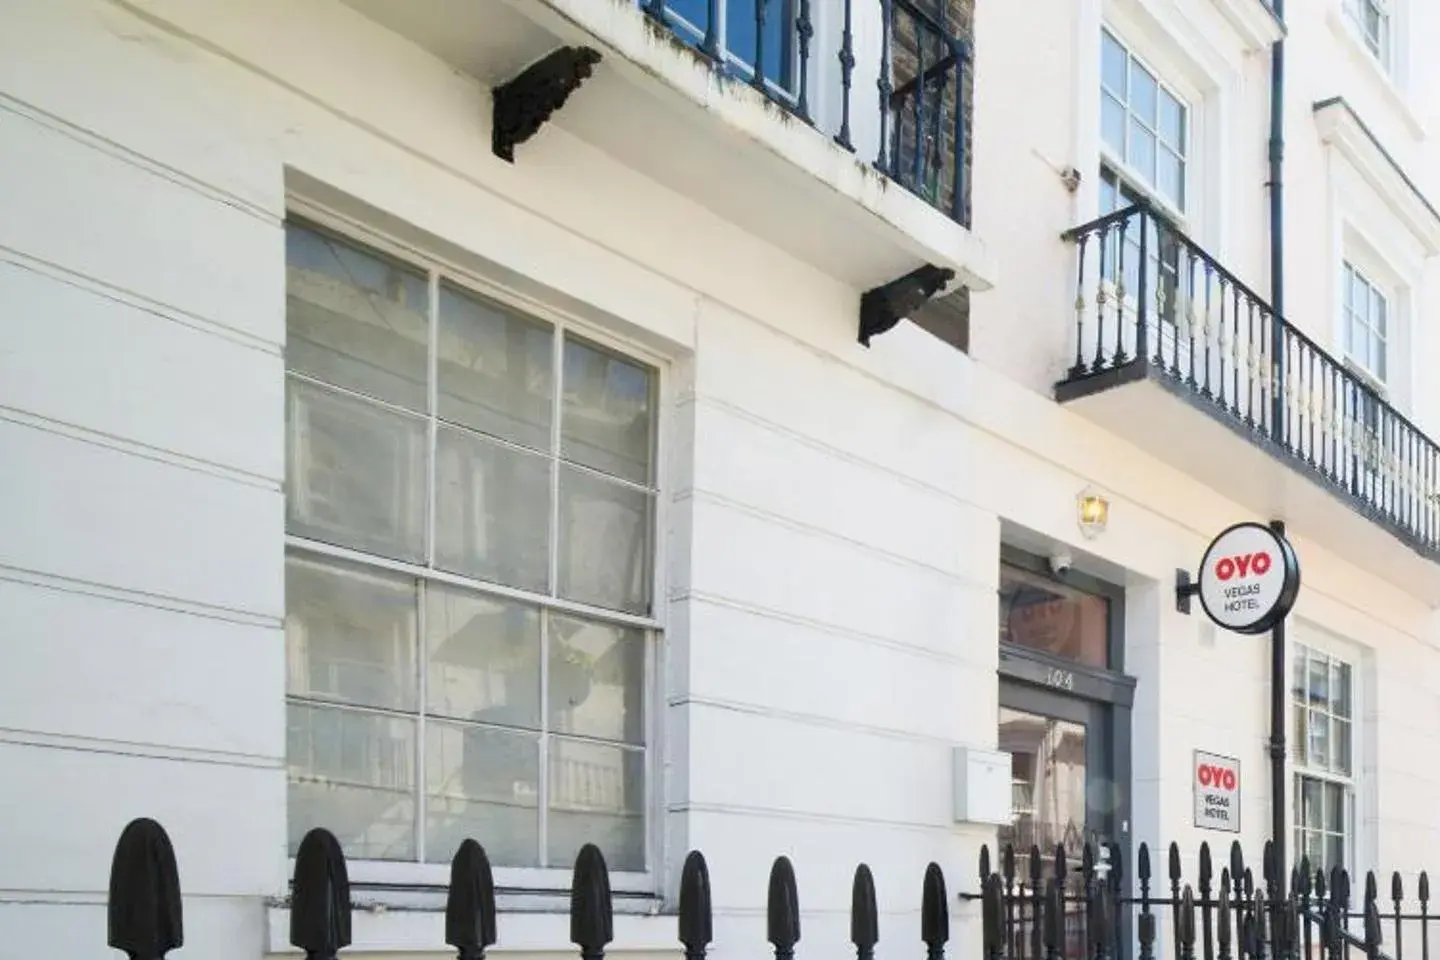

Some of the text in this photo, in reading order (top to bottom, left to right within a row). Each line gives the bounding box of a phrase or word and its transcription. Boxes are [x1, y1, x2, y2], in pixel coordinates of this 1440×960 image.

[1215, 551, 1272, 581] OYO
[1224, 583, 1261, 599] VEGAS
[1224, 598, 1260, 612] HOTEL
[1198, 764, 1236, 791] OYO
